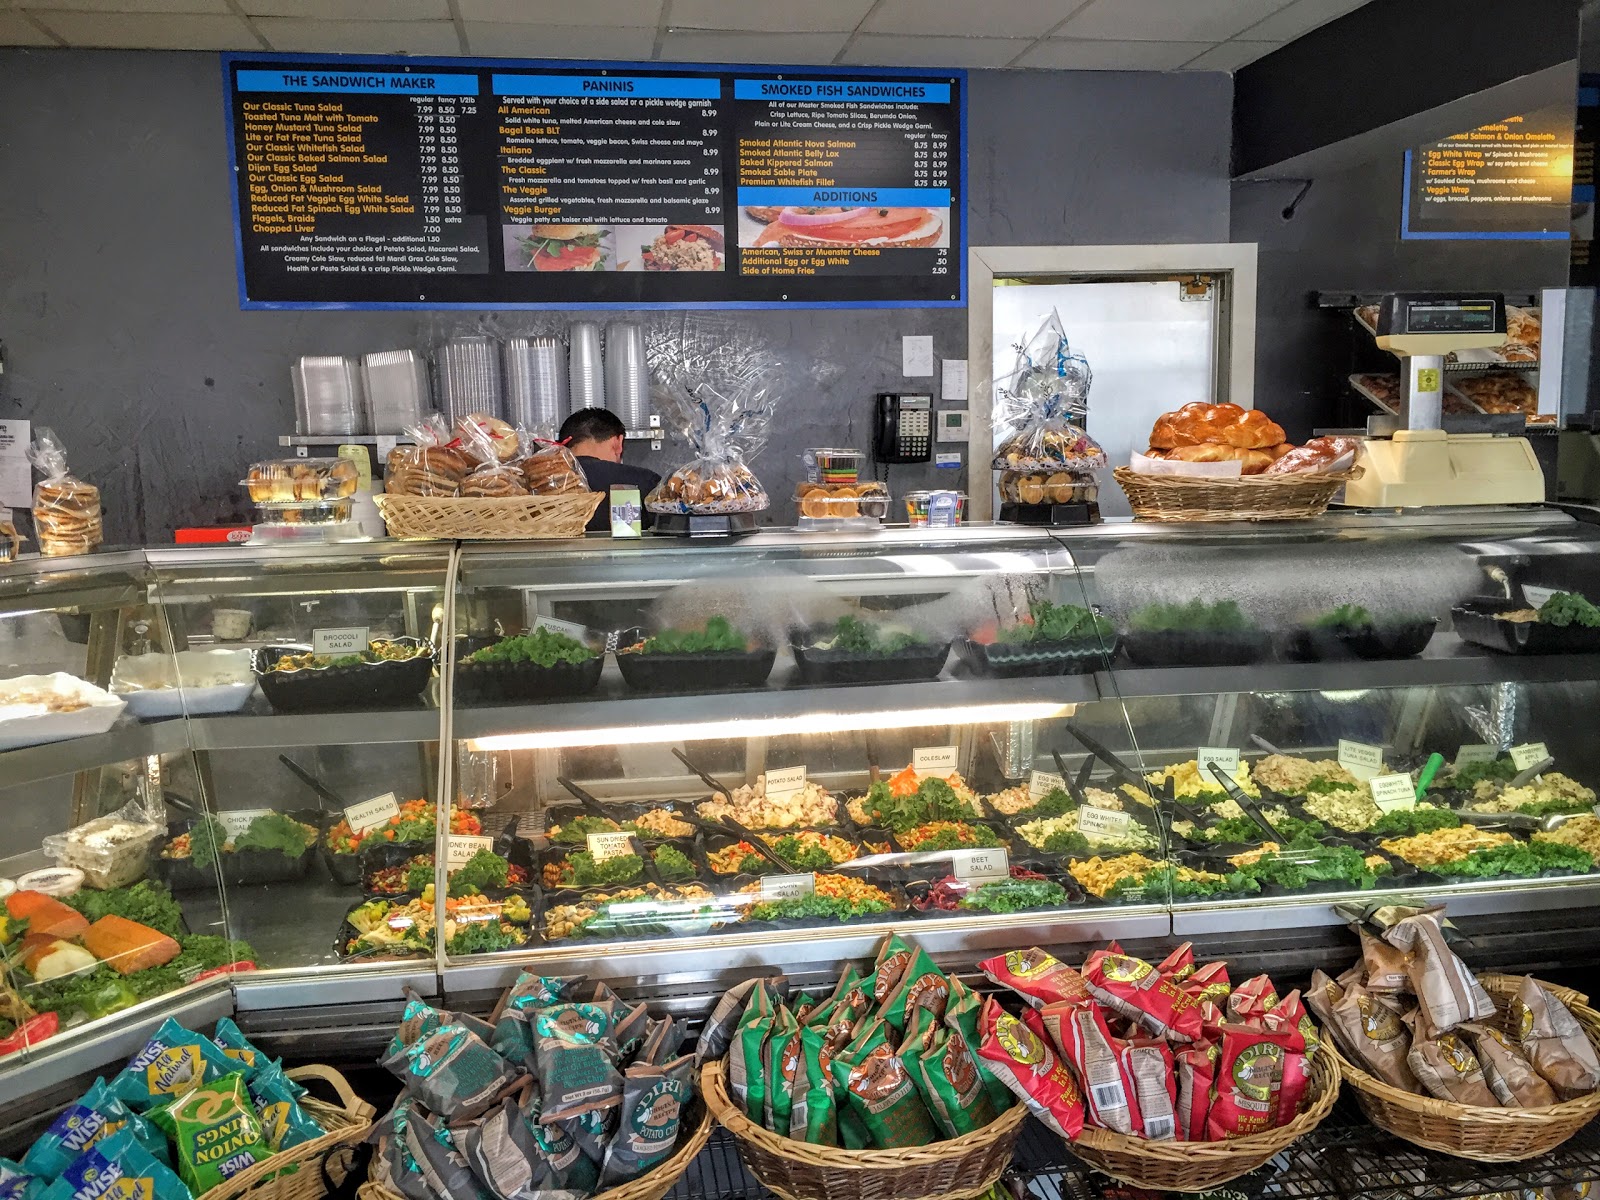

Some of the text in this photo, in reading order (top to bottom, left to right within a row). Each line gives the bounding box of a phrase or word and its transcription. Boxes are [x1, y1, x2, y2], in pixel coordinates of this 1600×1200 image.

[282, 75, 435, 88] THE SANDWICH MAKER
[582, 80, 633, 91] PANINIS
[761, 84, 925, 97] SMOKED FISH SANDWICHES
[262, 102, 292, 110] Classic
[244, 123, 273, 132] Honey
[499, 126, 522, 135] Bagel
[804, 150, 824, 158] Belly
[767, 158, 802, 167] Kippered
[248, 163, 270, 172] Dijon
[273, 164, 290, 173] Egg
[250, 184, 268, 193] Egg,
[309, 184, 354, 192] Mushroom
[519, 186, 547, 195] Veggie
[306, 194, 336, 204] Veggie
[338, 195, 354, 204] Egg
[813, 191, 877, 201] ADDITIONS
[503, 205, 561, 214] Veggie Burger
[252, 214, 285, 224] Flagels,
[252, 224, 292, 233] Chopped
[741, 247, 780, 255] American,
[784, 258, 798, 266] Egg
[811, 258, 825, 266] Egg
[351, 803, 394, 822] HEALTH SALAD
[130, 1040, 168, 1072] WISE
[156, 1054, 174, 1070] All
[155, 1048, 193, 1092] Natural
[62, 1110, 107, 1150] WISE
[219, 1152, 256, 1175] WISE
[74, 1162, 124, 1200] WISE
